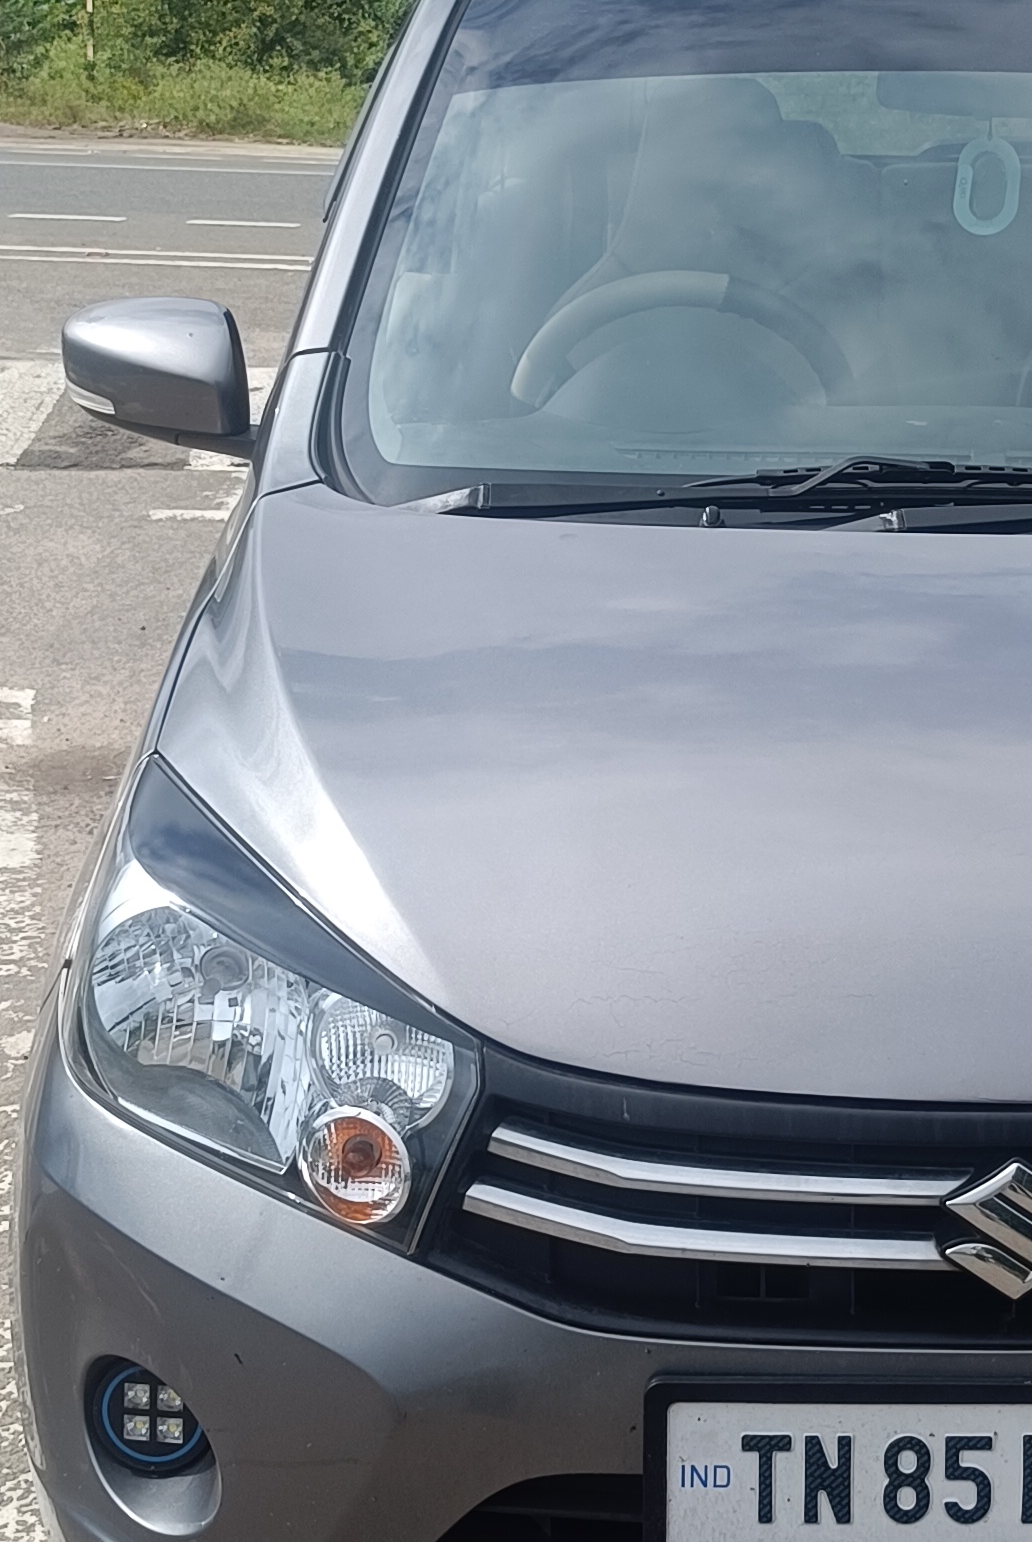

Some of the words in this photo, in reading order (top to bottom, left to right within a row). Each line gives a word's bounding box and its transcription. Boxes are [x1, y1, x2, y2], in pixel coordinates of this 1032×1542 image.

[680, 1464, 731, 1488] IND
[741, 1434, 852, 1524] TN
[883, 1435, 993, 1524] 85
